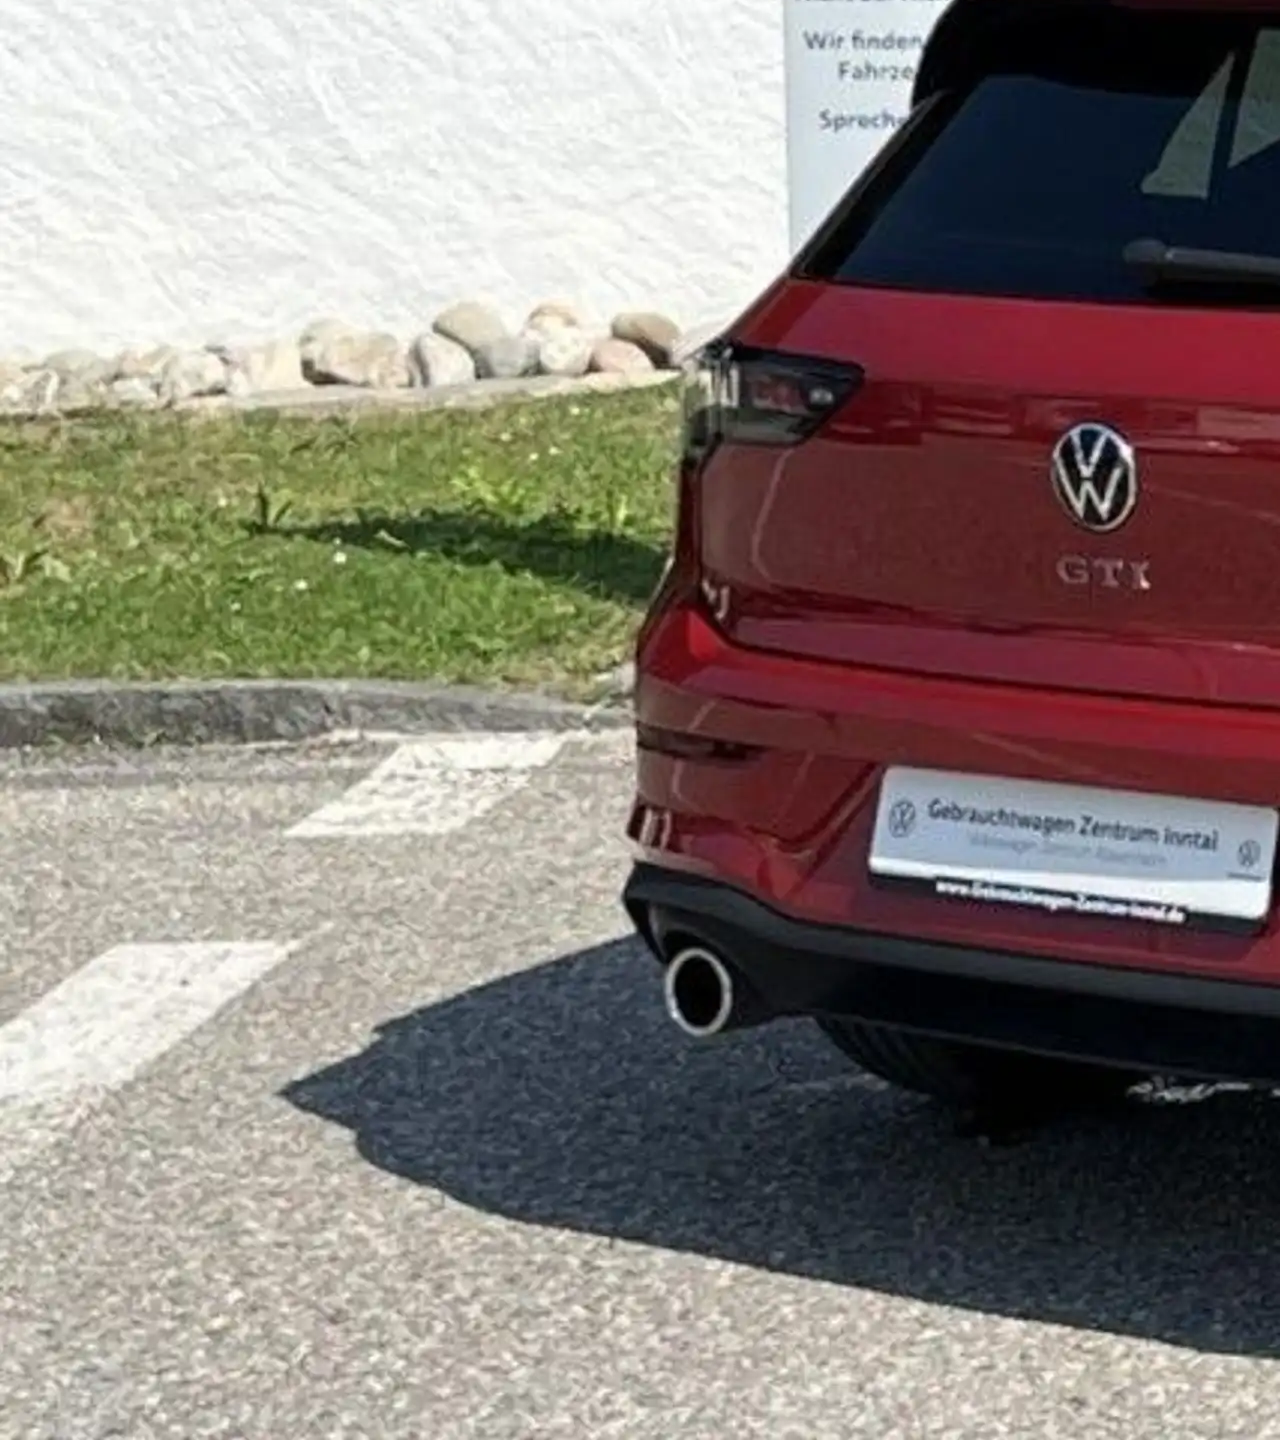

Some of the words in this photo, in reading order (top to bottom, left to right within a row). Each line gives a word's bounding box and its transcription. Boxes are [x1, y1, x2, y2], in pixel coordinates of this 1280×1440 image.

[803, 30, 846, 50] Wir
[851, 29, 923, 50] finden
[1056, 555, 1151, 589] GTI
[928, 798, 1076, 836] Gebrauchtwagen
[1079, 815, 1160, 845] Zentrum
